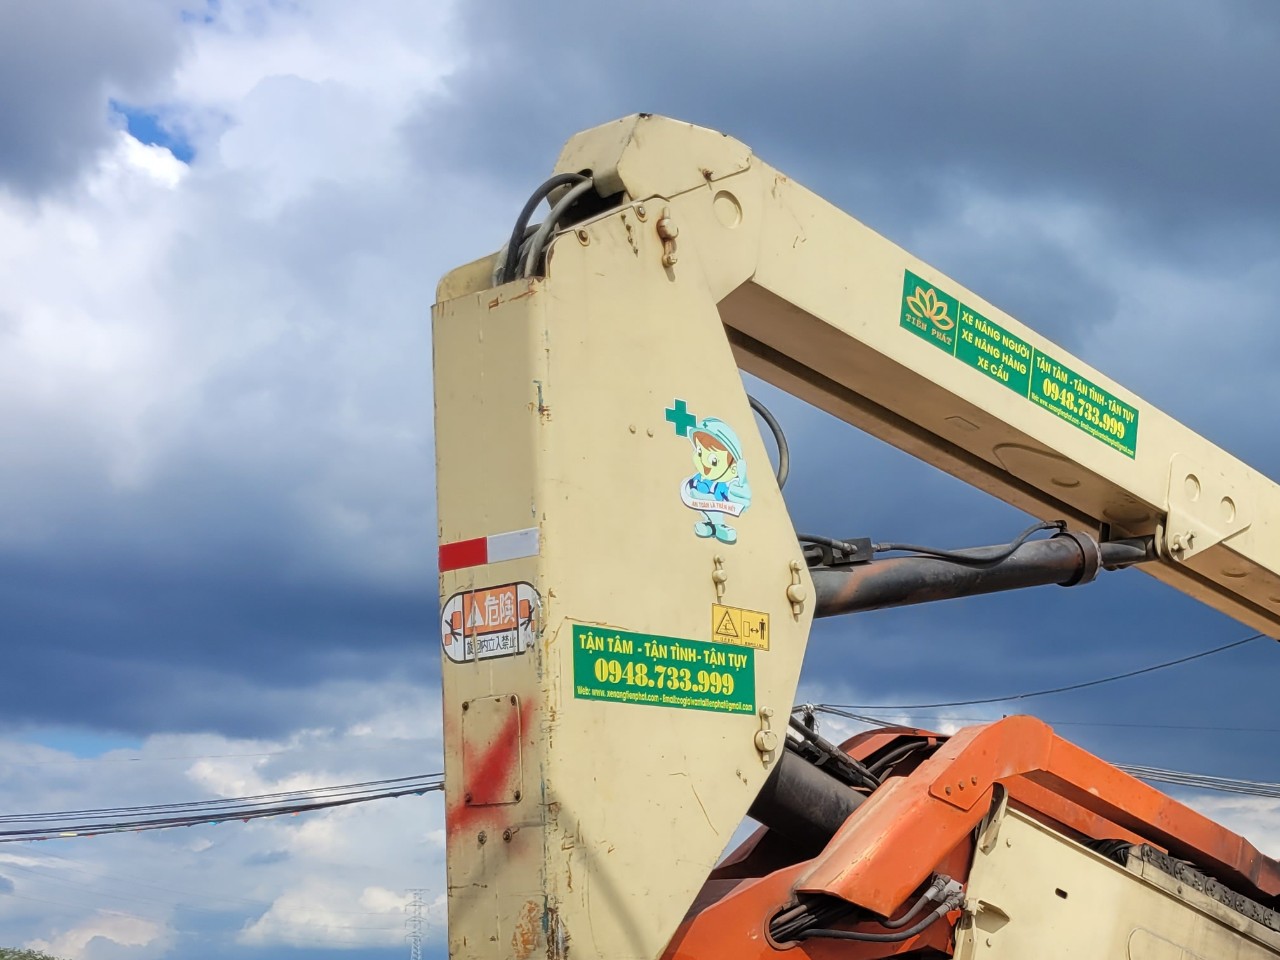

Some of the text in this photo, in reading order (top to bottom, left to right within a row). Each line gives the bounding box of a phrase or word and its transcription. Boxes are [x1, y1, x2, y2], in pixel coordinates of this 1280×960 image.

[962, 311, 1029, 359] XE NÂNG NGƯỜI
[962, 329, 1026, 375] XE NÂNG HÀNG
[978, 356, 988, 370] XE
[1037, 356, 1050, 375] TẬN
[1053, 364, 1067, 384] TÂM
[1074, 377, 1087, 397] TẬN
[1089, 384, 1104, 406] TÌNH
[1108, 399, 1122, 418] TẬN
[1122, 408, 1135, 424] TỤY
[1043, 378, 1125, 440] 0948.733.999
[579, 632, 603, 654] TẬN
[608, 636, 633, 654] TÂM
[644, 640, 668, 662] TẬN
[672, 642, 696, 662] TÌNH
[704, 646, 726, 668] TẬN
[728, 652, 748, 671] TỤY
[594, 657, 734, 696] 0948.733.999
